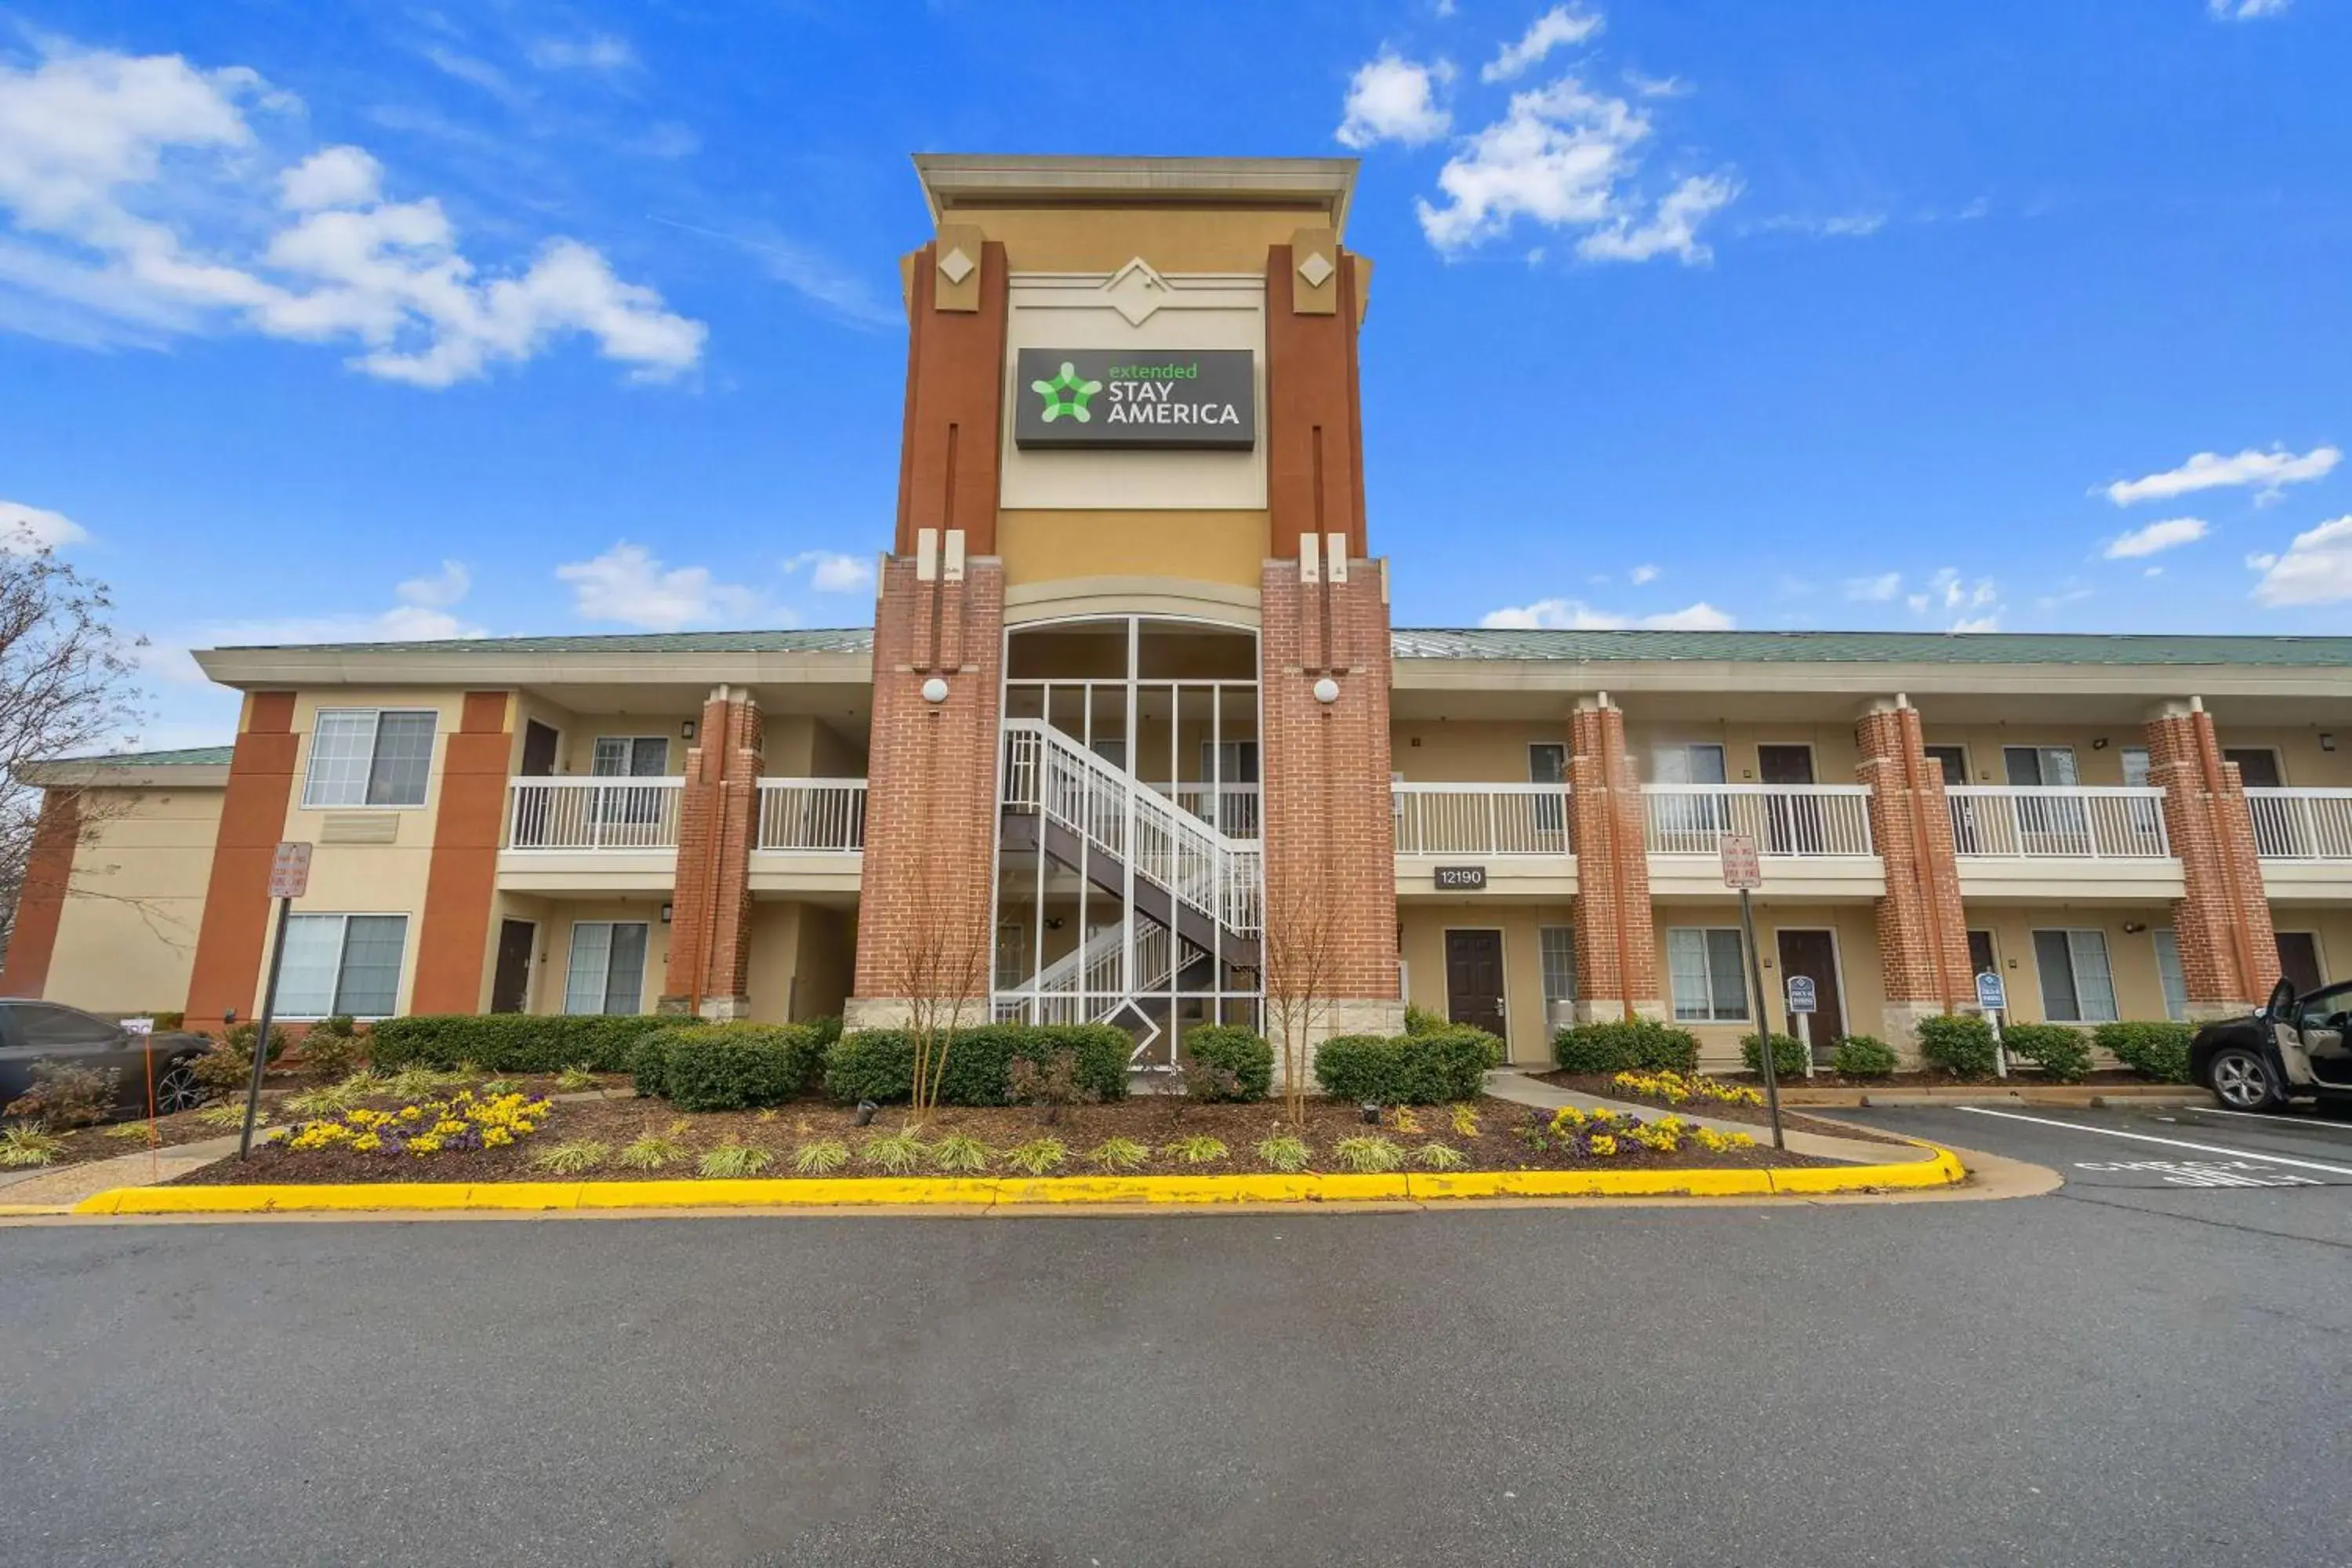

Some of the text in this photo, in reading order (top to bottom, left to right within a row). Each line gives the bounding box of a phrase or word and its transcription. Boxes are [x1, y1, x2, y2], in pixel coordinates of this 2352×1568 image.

[1109, 363, 1198, 378] extended
[1108, 381, 1174, 402] STAY
[1107, 404, 1240, 424] AMERICA
[1442, 871, 1481, 884] 12190
